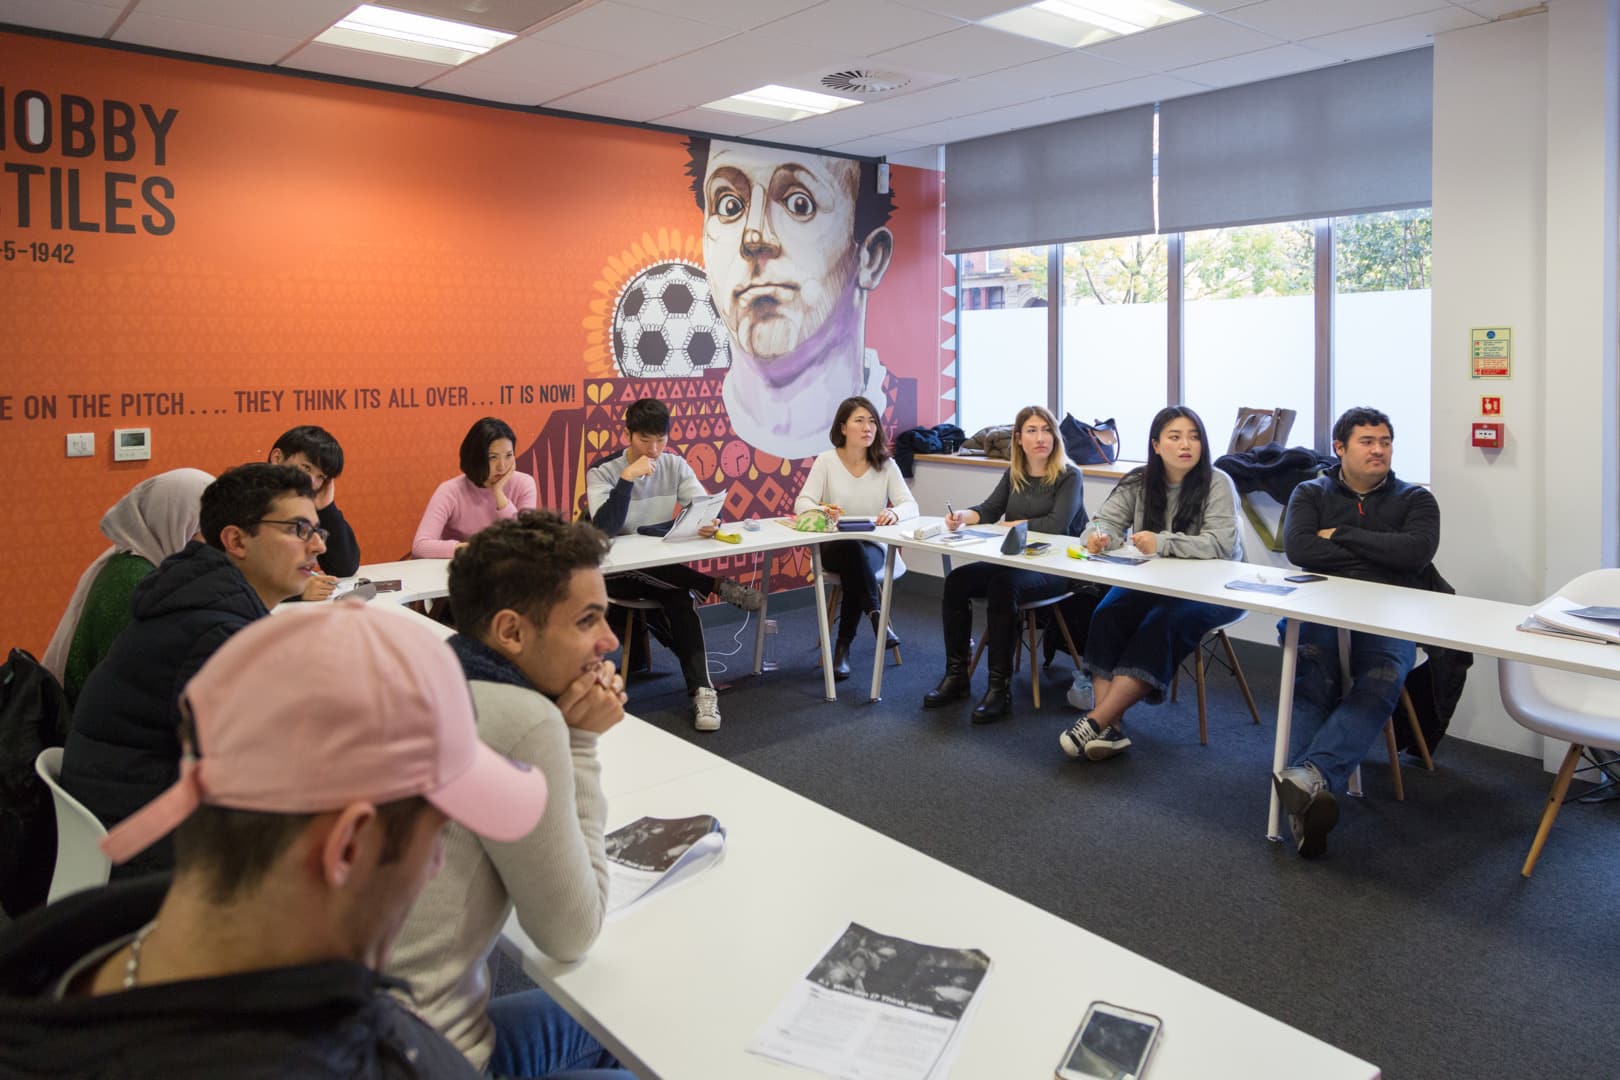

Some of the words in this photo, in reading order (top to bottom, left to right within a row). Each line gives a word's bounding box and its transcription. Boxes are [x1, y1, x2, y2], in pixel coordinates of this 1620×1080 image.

[0, 86, 179, 166] OBBY
[0, 162, 175, 236] TILES
[24, 395, 57, 420] ON
[68, 394, 111, 418] THE
[235, 390, 284, 413] THEY
[293, 389, 347, 411] THINK
[354, 388, 381, 409] ITS
[389, 388, 419, 408] ALL
[500, 385, 514, 404] IT
[520, 385, 533, 404] IS
[539, 384, 576, 404] NOW!
